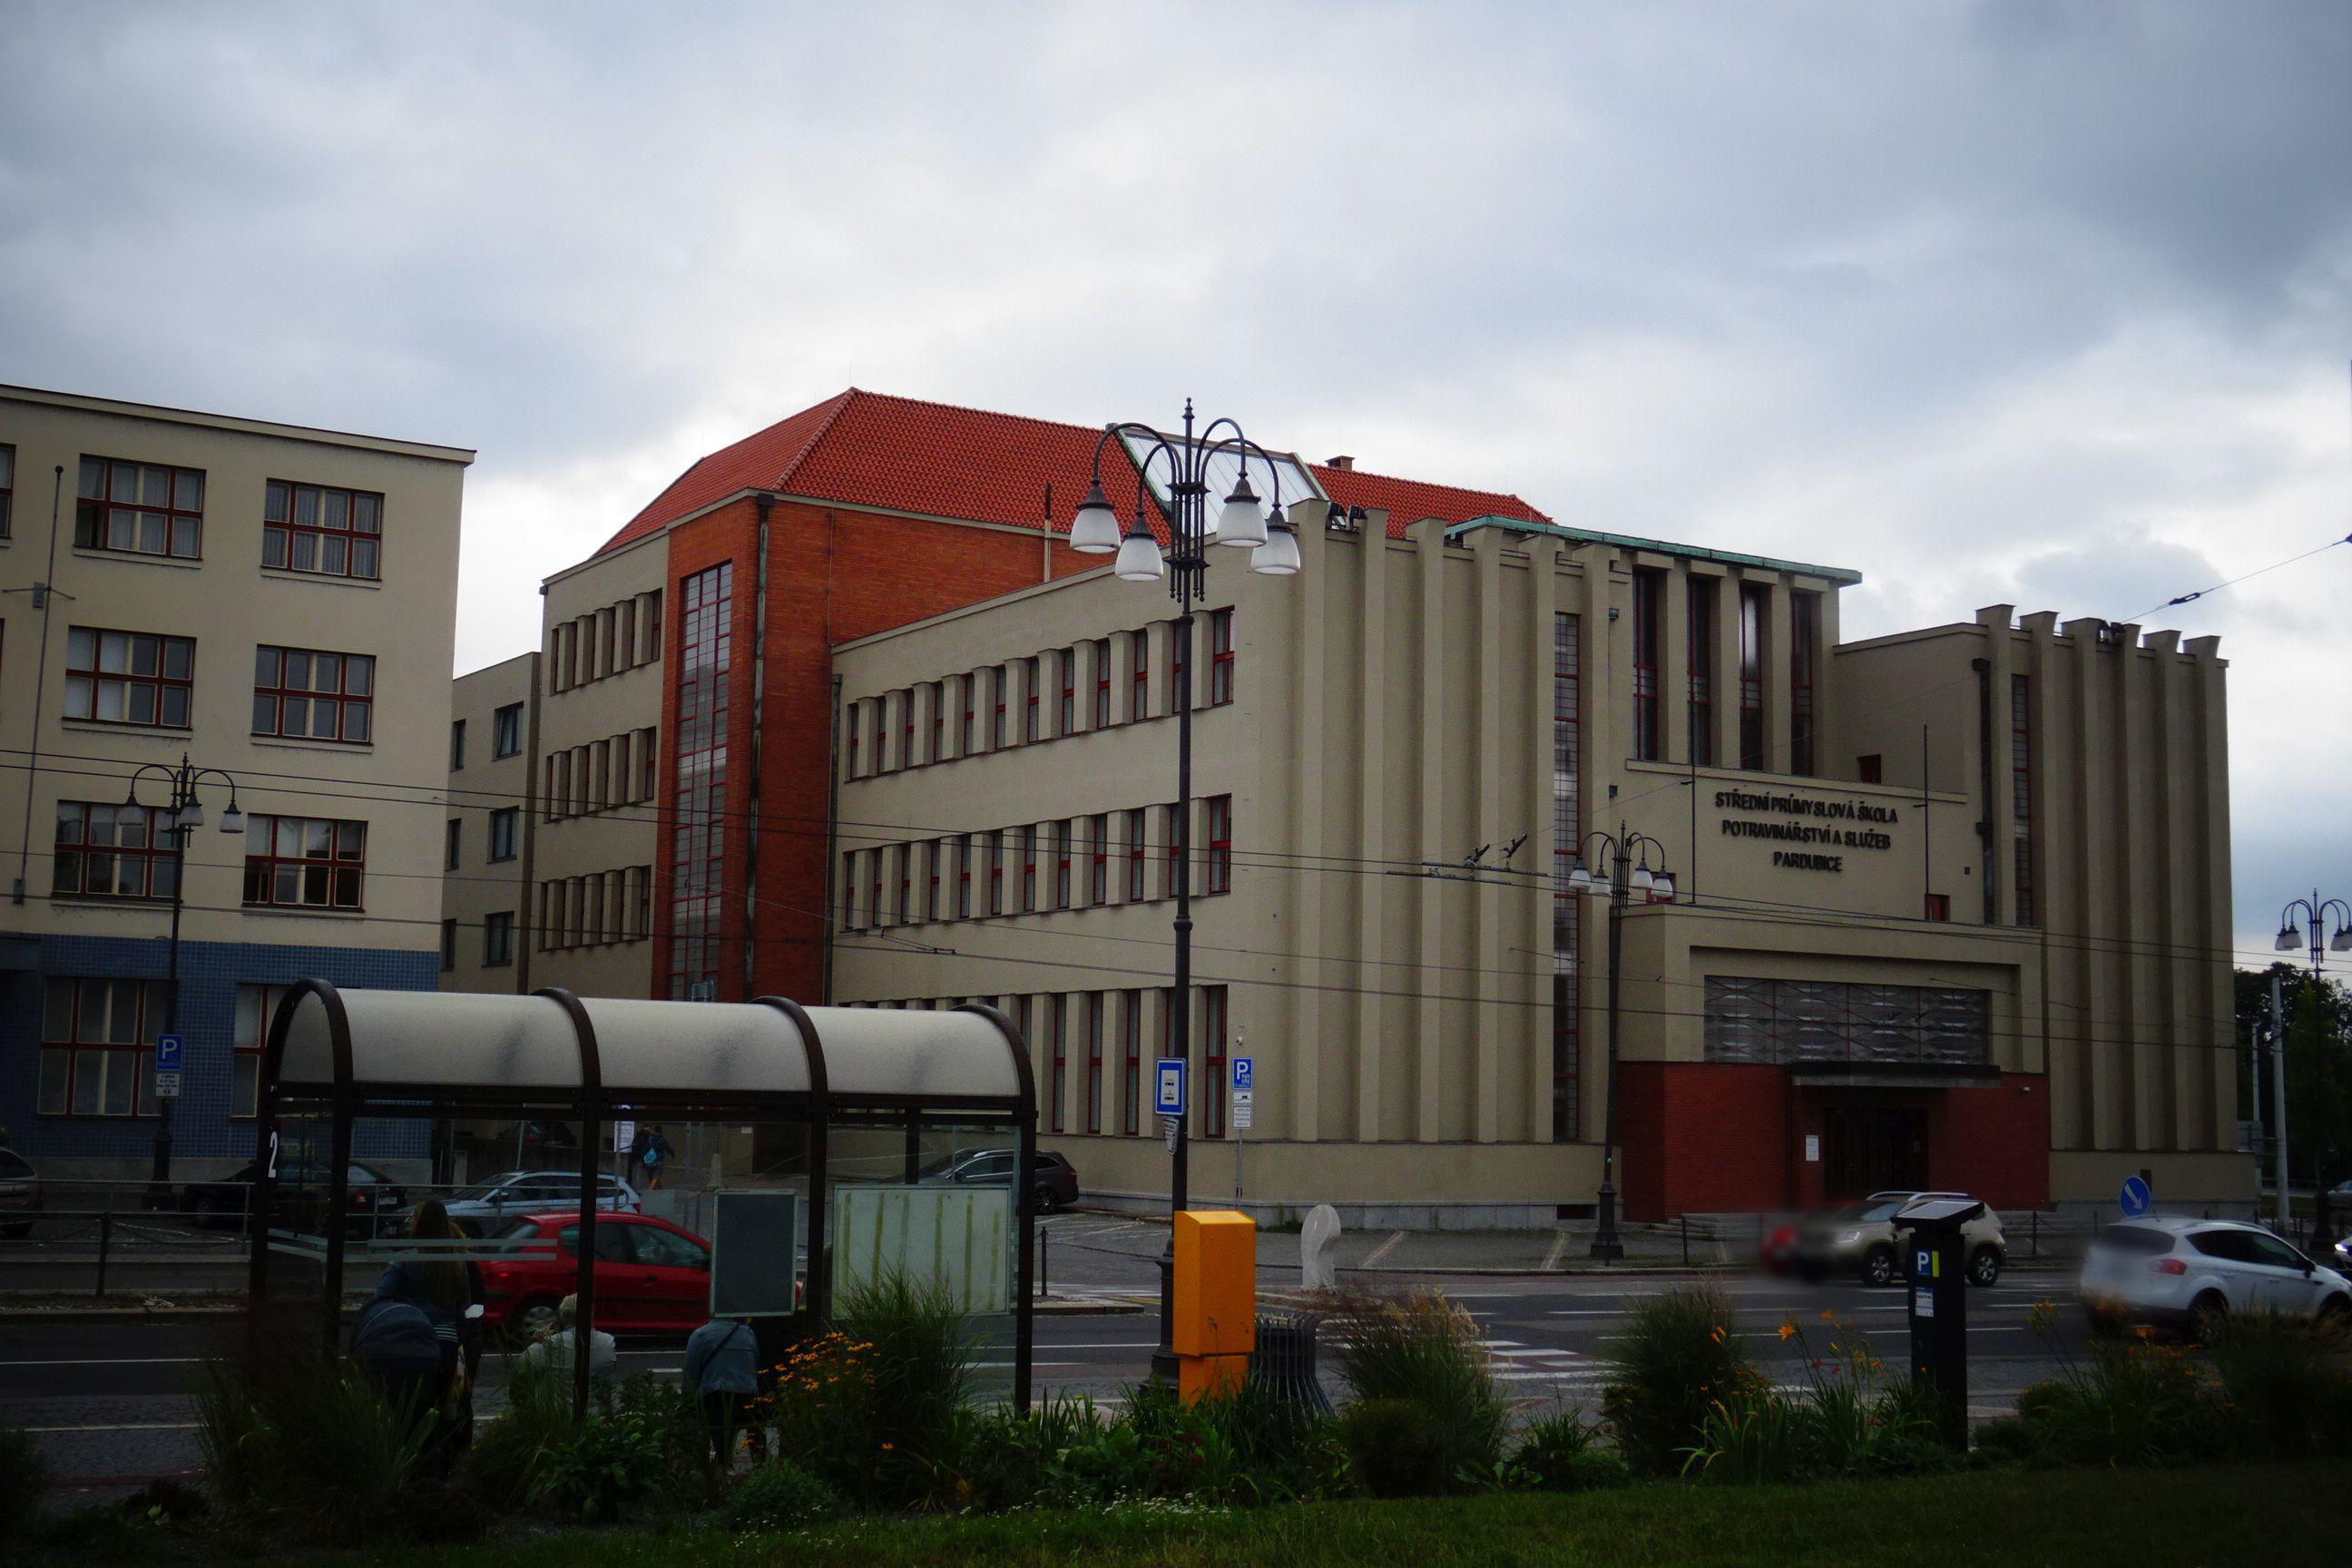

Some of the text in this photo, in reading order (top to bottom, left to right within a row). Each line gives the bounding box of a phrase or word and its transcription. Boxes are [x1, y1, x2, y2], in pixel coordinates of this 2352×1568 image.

[1715, 789, 1897, 824] STŘEDNÍ PRŮMYSLOVÁ ŠKOLA
[1722, 819, 1891, 849] POTRAVINÁŘSTVÍ A SLUŽEB
[1773, 851, 1843, 872] PARDUBICE
[162, 1039, 178, 1060] P
[1236, 1061, 1249, 1081] P
[268, 1131, 278, 1178] 2
[1917, 1251, 1929, 1272] P
